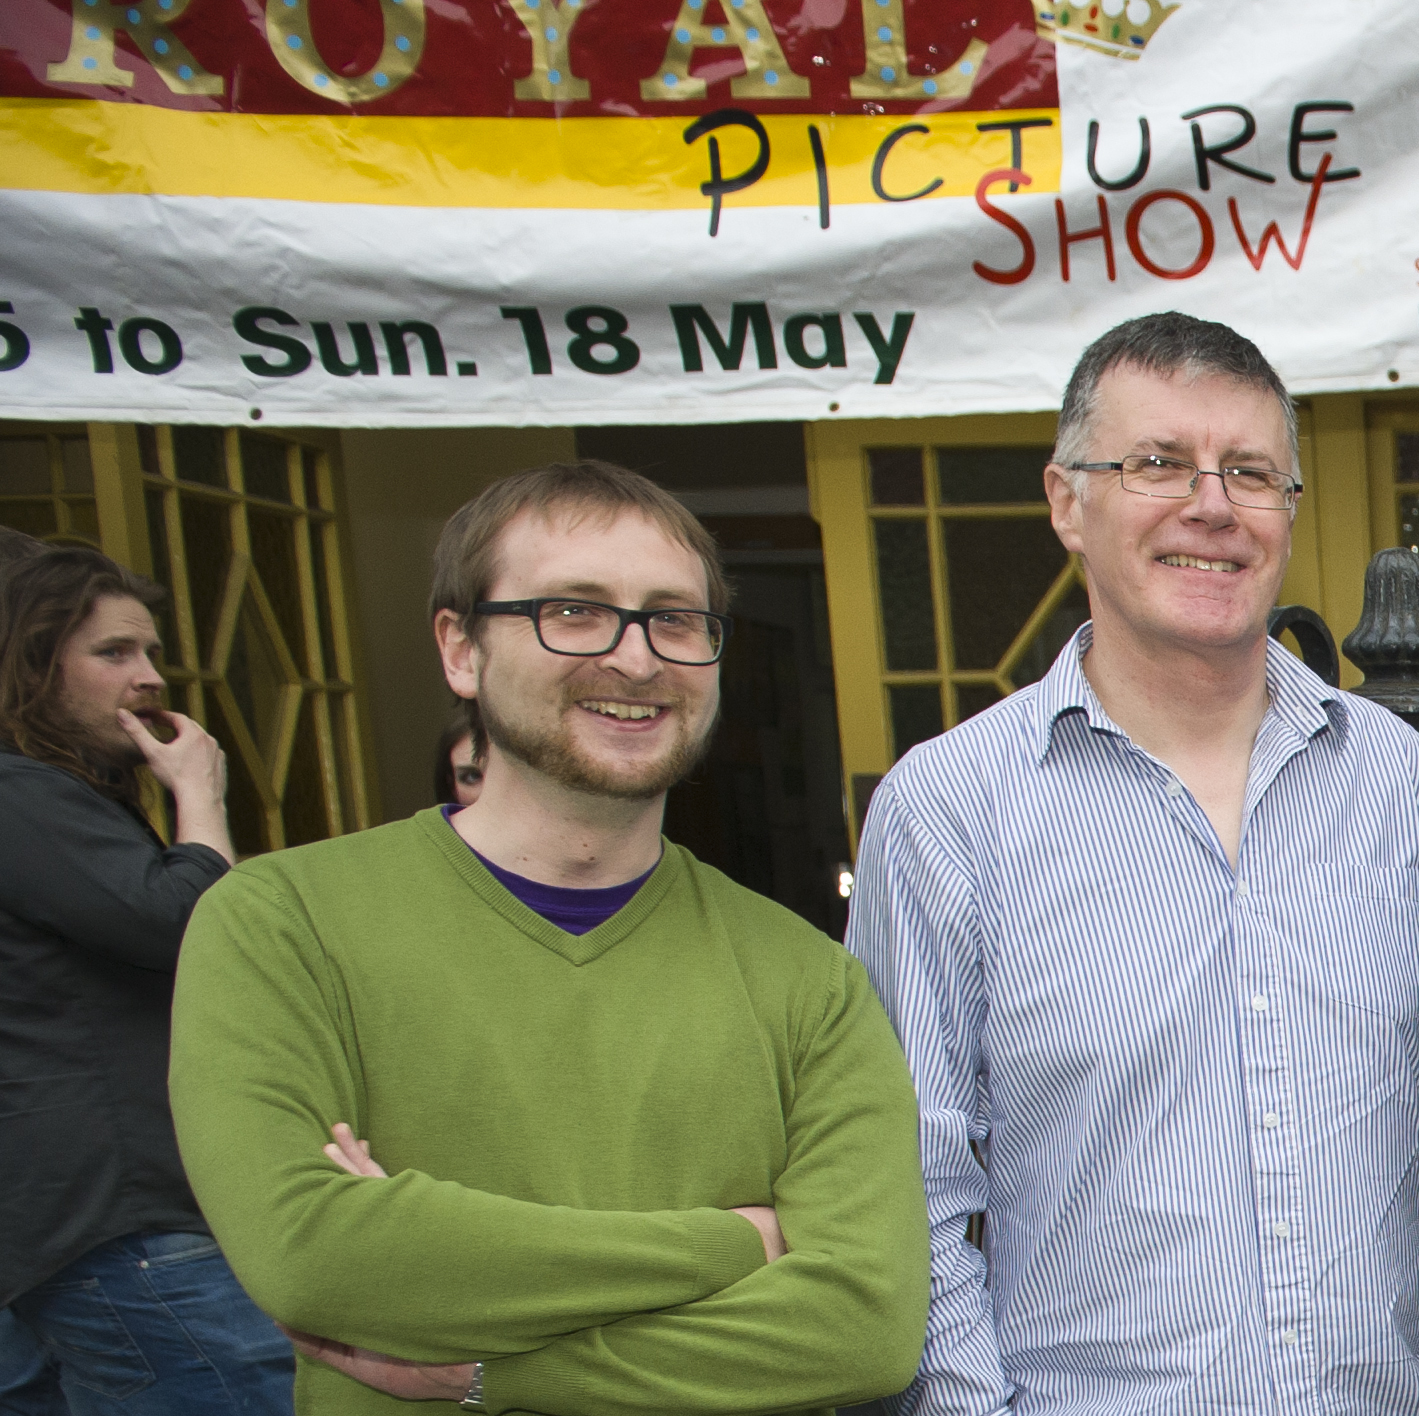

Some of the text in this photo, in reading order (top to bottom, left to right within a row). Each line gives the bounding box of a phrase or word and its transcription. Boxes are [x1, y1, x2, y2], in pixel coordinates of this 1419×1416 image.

[683, 101, 1361, 237] PICTURE
[972, 153, 1332, 285] SHOW
[73, 306, 184, 376] to
[232, 305, 478, 377] Sun.
[500, 304, 642, 375] 18
[669, 300, 916, 386] May
